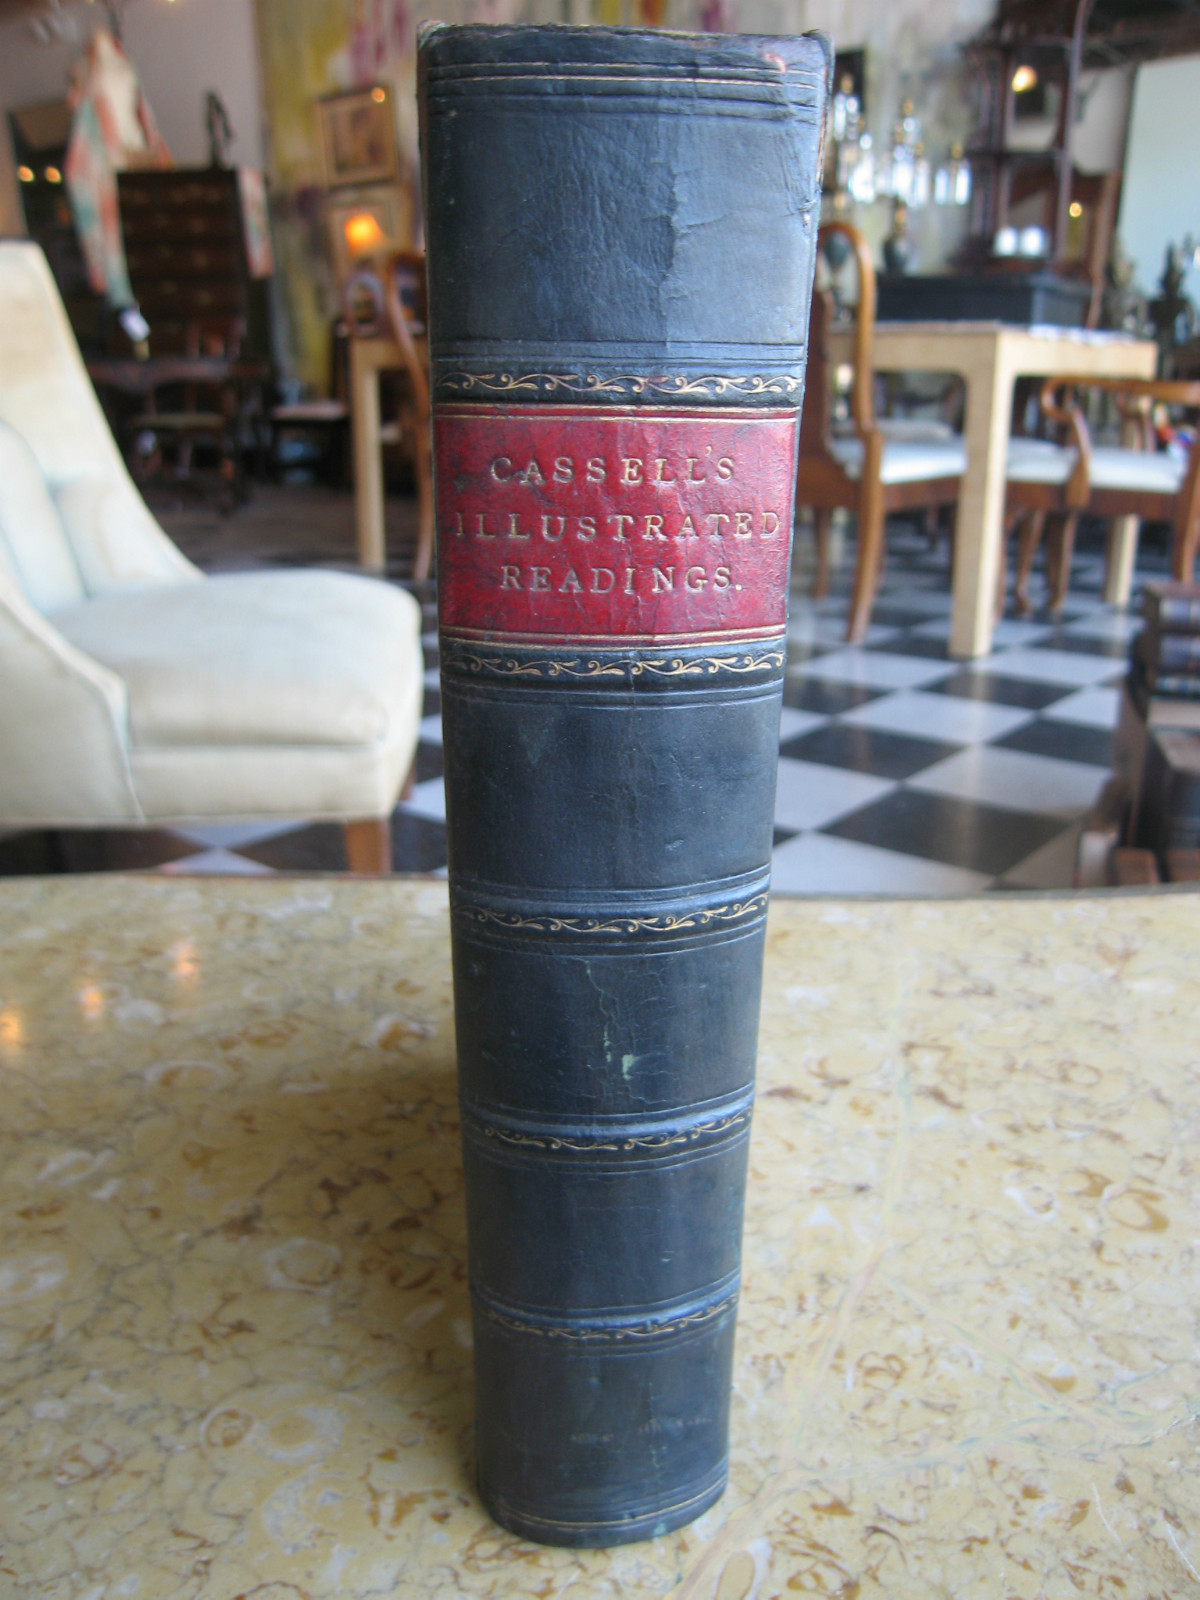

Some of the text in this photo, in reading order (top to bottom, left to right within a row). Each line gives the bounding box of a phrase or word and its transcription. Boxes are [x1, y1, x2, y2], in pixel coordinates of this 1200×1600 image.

[490, 446, 735, 485] CASSELL'S
[455, 511, 781, 542] ILLUSTRATED
[500, 564, 742, 595] READINGS.
